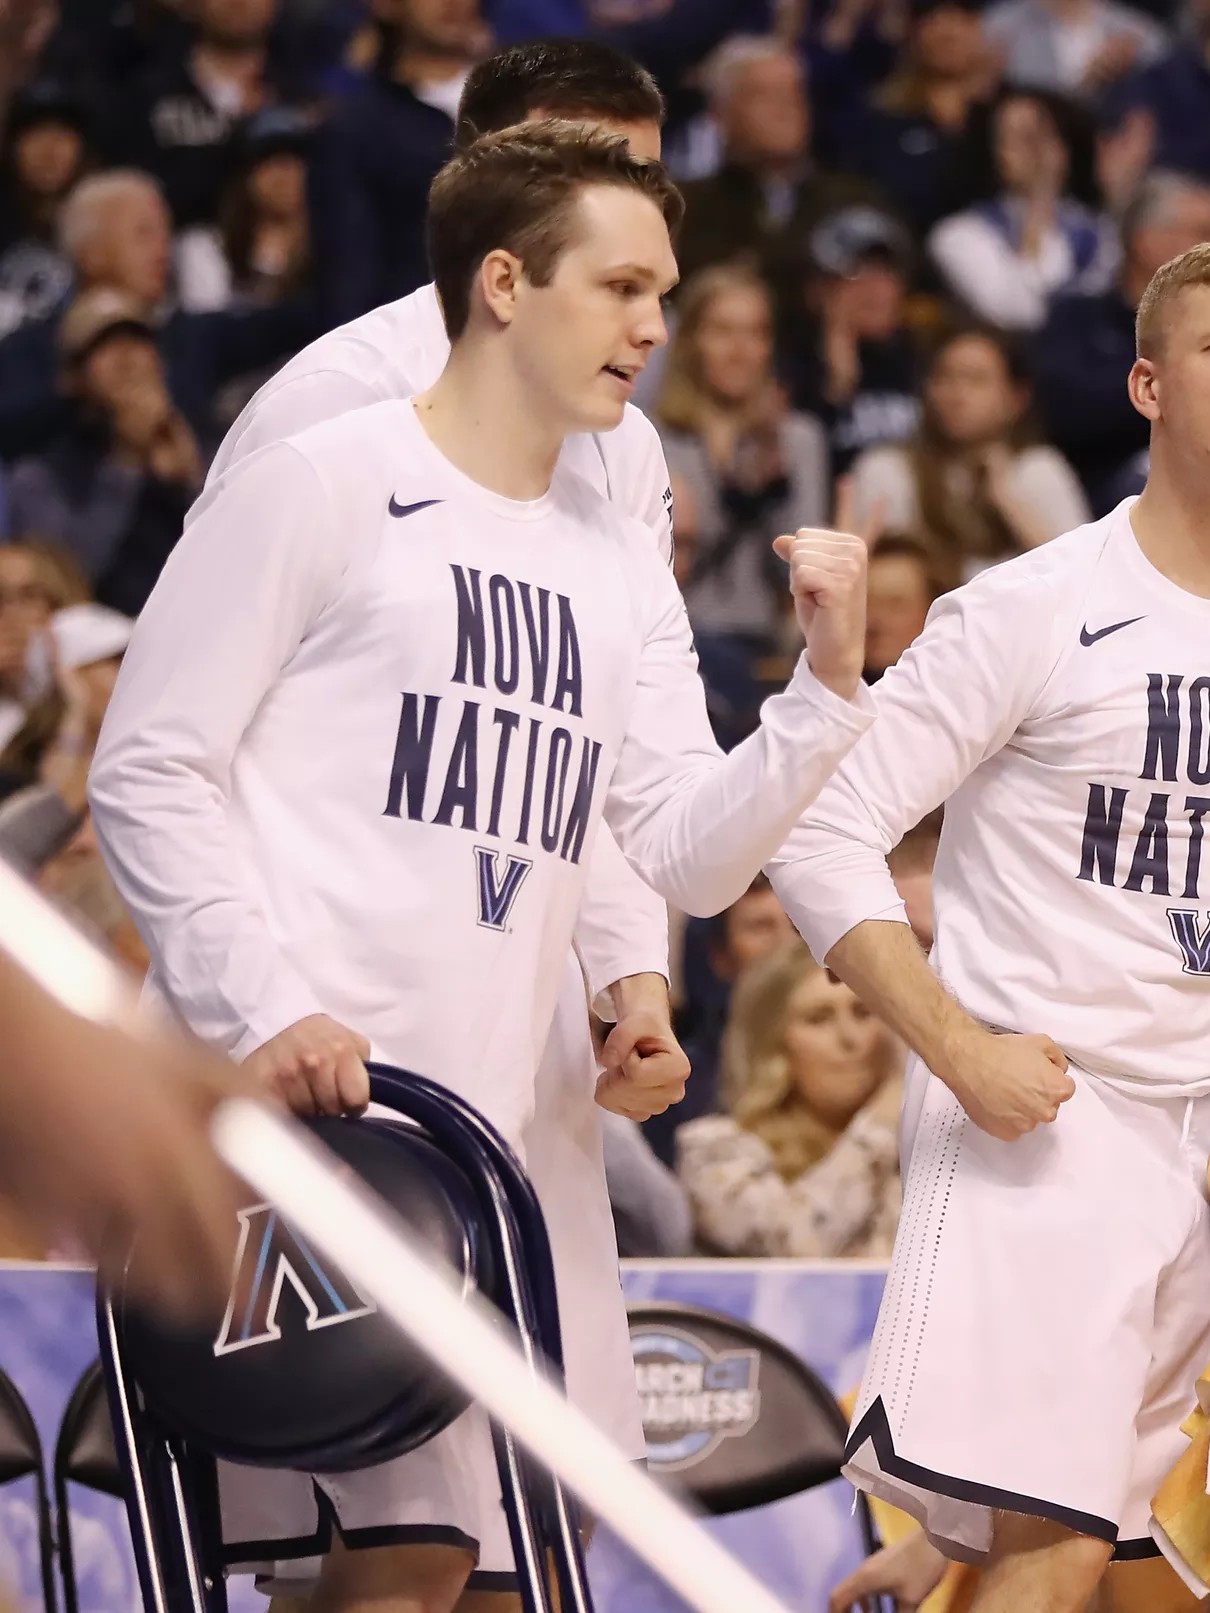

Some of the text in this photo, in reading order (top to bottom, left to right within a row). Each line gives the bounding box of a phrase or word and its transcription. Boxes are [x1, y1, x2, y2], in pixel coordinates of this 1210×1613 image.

[449, 563, 583, 718] NOVA
[381, 692, 603, 865] NATION
[634, 1363, 705, 1397] ARCH
[640, 1389, 754, 1423] ADNESS
